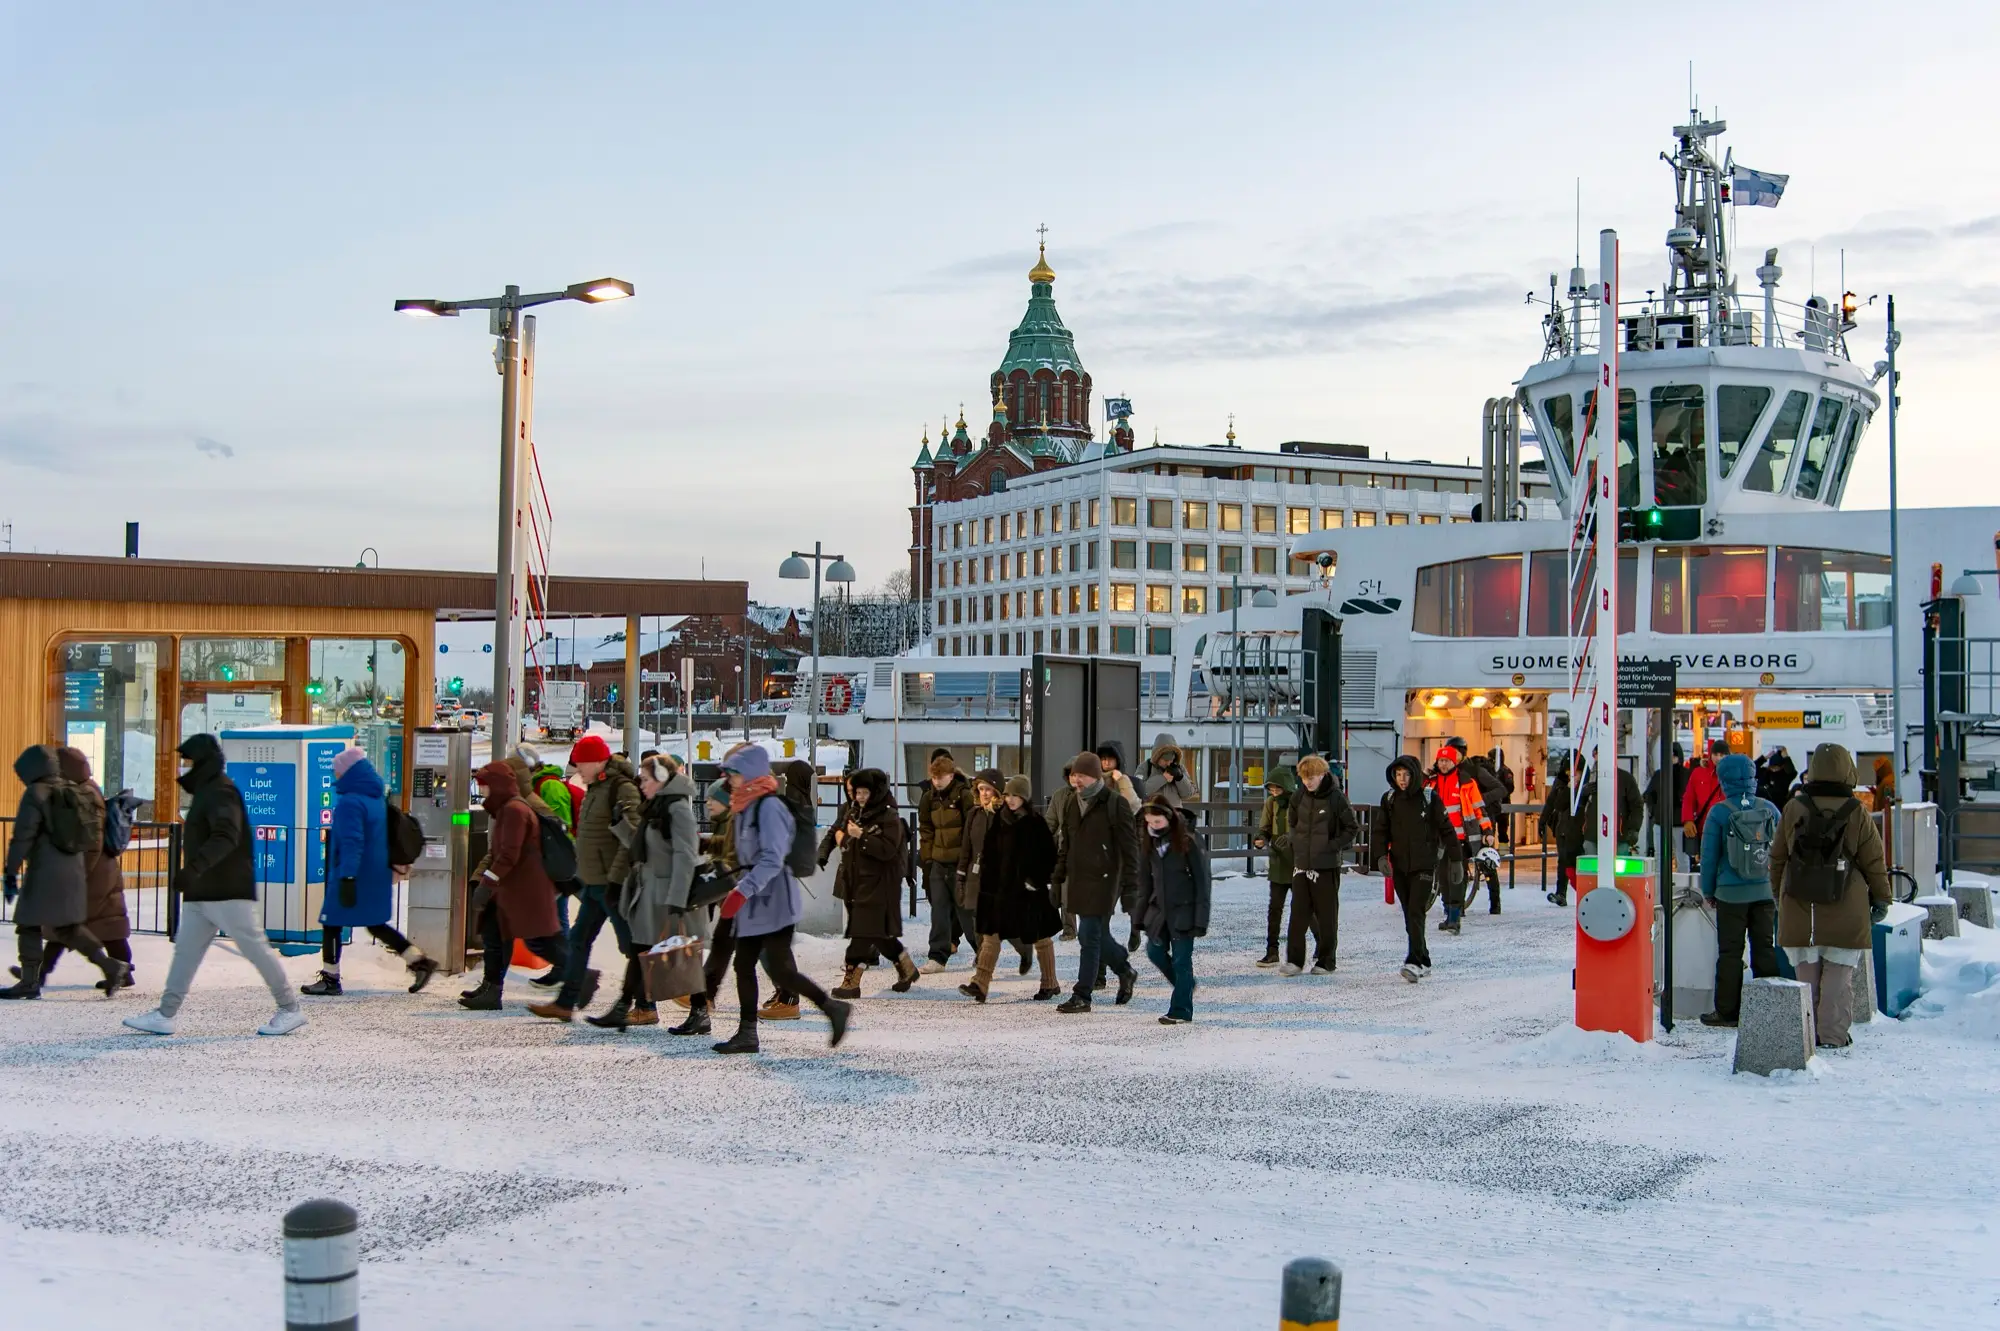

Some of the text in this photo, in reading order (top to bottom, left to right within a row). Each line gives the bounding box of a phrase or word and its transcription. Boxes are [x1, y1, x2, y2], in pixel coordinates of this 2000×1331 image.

[1492, 654, 1797, 669] SUOMENL SVEABORG
[1616, 665, 1649, 673] ukasportti
[1642, 673, 1672, 682] invånare
[1640, 683, 1655, 691] only
[1767, 714, 1845, 724] avesco CAT KAT
[250, 778, 272, 789] Liput
[244, 791, 278, 803] Biljetter
[246, 804, 276, 815] Tickets
